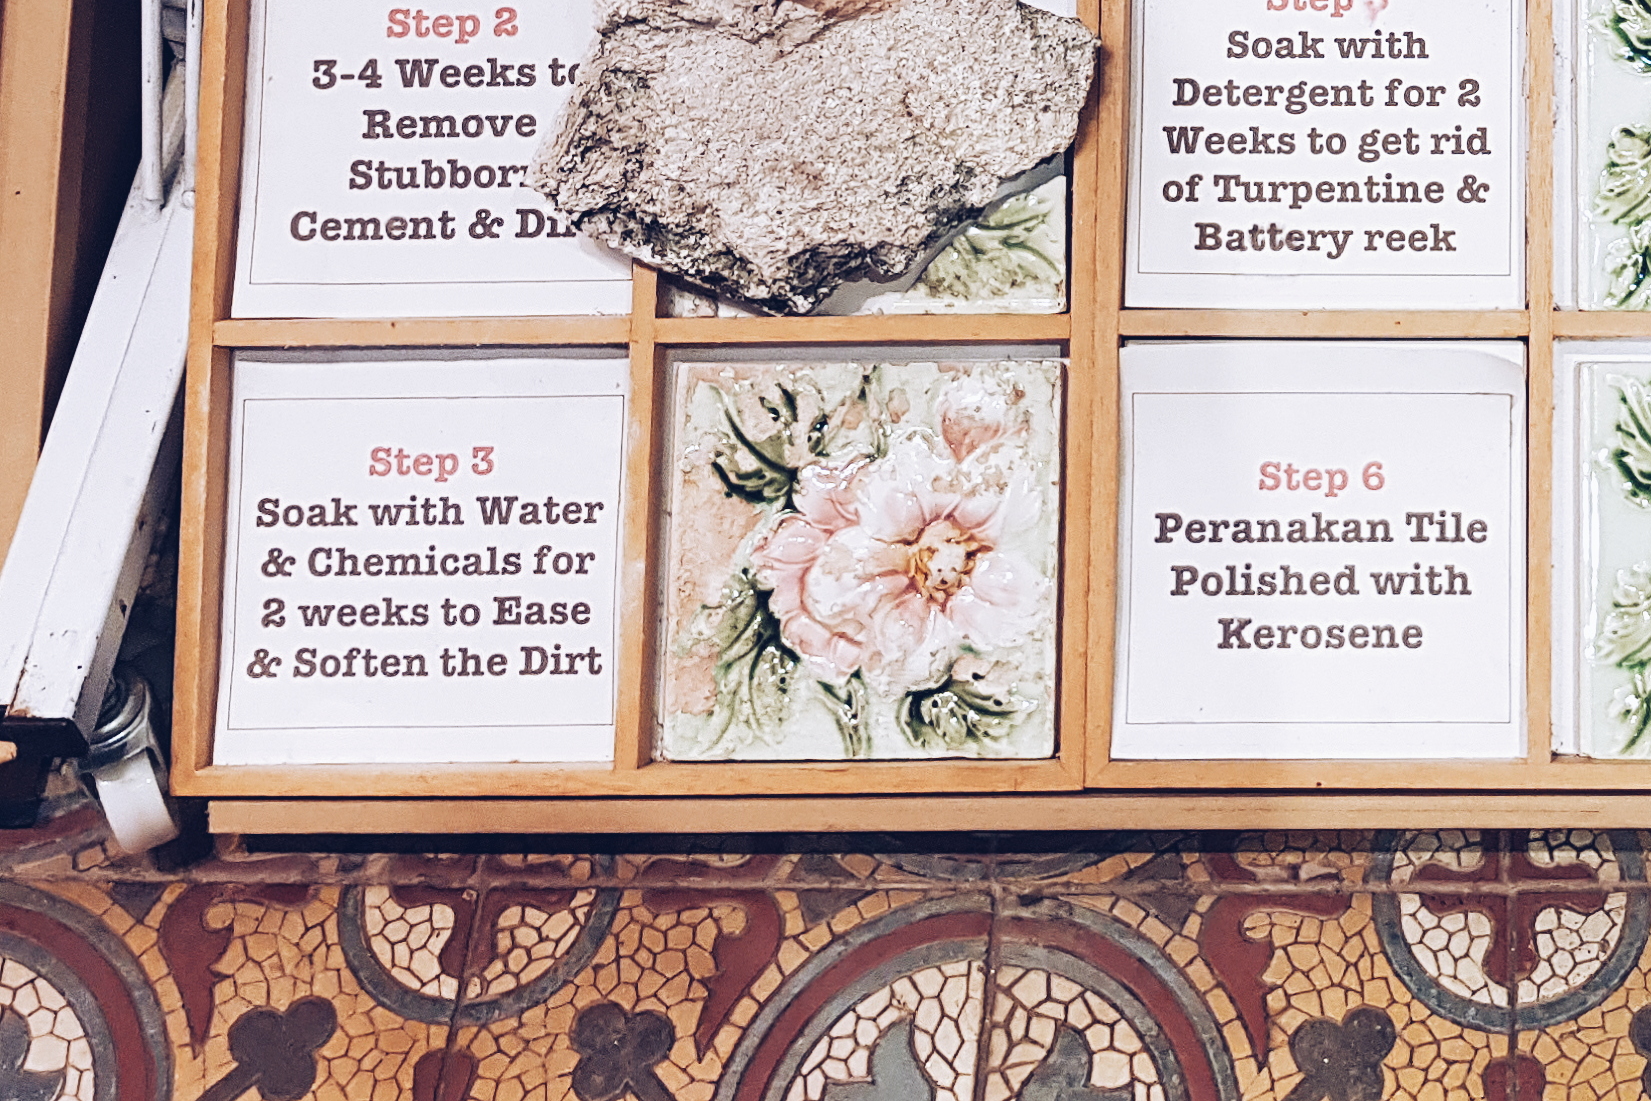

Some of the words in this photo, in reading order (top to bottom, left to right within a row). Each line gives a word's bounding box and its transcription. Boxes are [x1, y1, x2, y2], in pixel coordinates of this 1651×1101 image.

[386, 8, 480, 44] Step
[494, 8, 518, 38] 2
[1227, 31, 1324, 60] Soak
[1334, 29, 1429, 60] with
[312, 59, 382, 89] 3-4
[395, 58, 536, 88] Weeks
[1173, 78, 1374, 114] Detergent
[1385, 79, 1446, 107] for
[1457, 79, 1481, 107] 2
[362, 109, 536, 139] Remove
[1163, 126, 1295, 155] Weeks
[1308, 127, 1346, 155] to
[1358, 127, 1419, 163] get
[1431, 125, 1491, 155] rid
[349, 159, 529, 190] Stubbor
[1163, 175, 1203, 203] of
[1214, 174, 1444, 209] Turpentine
[1457, 174, 1490, 204] &
[290, 210, 455, 241] Cement
[468, 209, 504, 239] &
[1194, 222, 1353, 259] Battery
[1364, 223, 1457, 252] reek
[369, 447, 459, 482] Step
[472, 446, 494, 475] 3
[1259, 462, 1348, 498] Step
[1362, 462, 1385, 490] 6
[256, 498, 358, 527] Soak
[368, 495, 463, 526] with
[476, 496, 604, 525] Water
[1154, 512, 1392, 543] Peranakan
[1405, 510, 1488, 543] Tile
[261, 547, 295, 577] &
[307, 545, 521, 577] Chemicals
[533, 545, 595, 576] for
[1170, 563, 1359, 597] Polished
[1370, 563, 1472, 596] with
[262, 598, 286, 628] 2
[298, 598, 429, 627] weeks
[440, 598, 481, 626] to
[493, 596, 591, 625] Ease
[1218, 618, 1423, 649] Kerosene
[247, 649, 282, 678] &
[292, 647, 428, 677] Soften
[440, 647, 508, 676] the
[519, 646, 602, 676] Dirt
